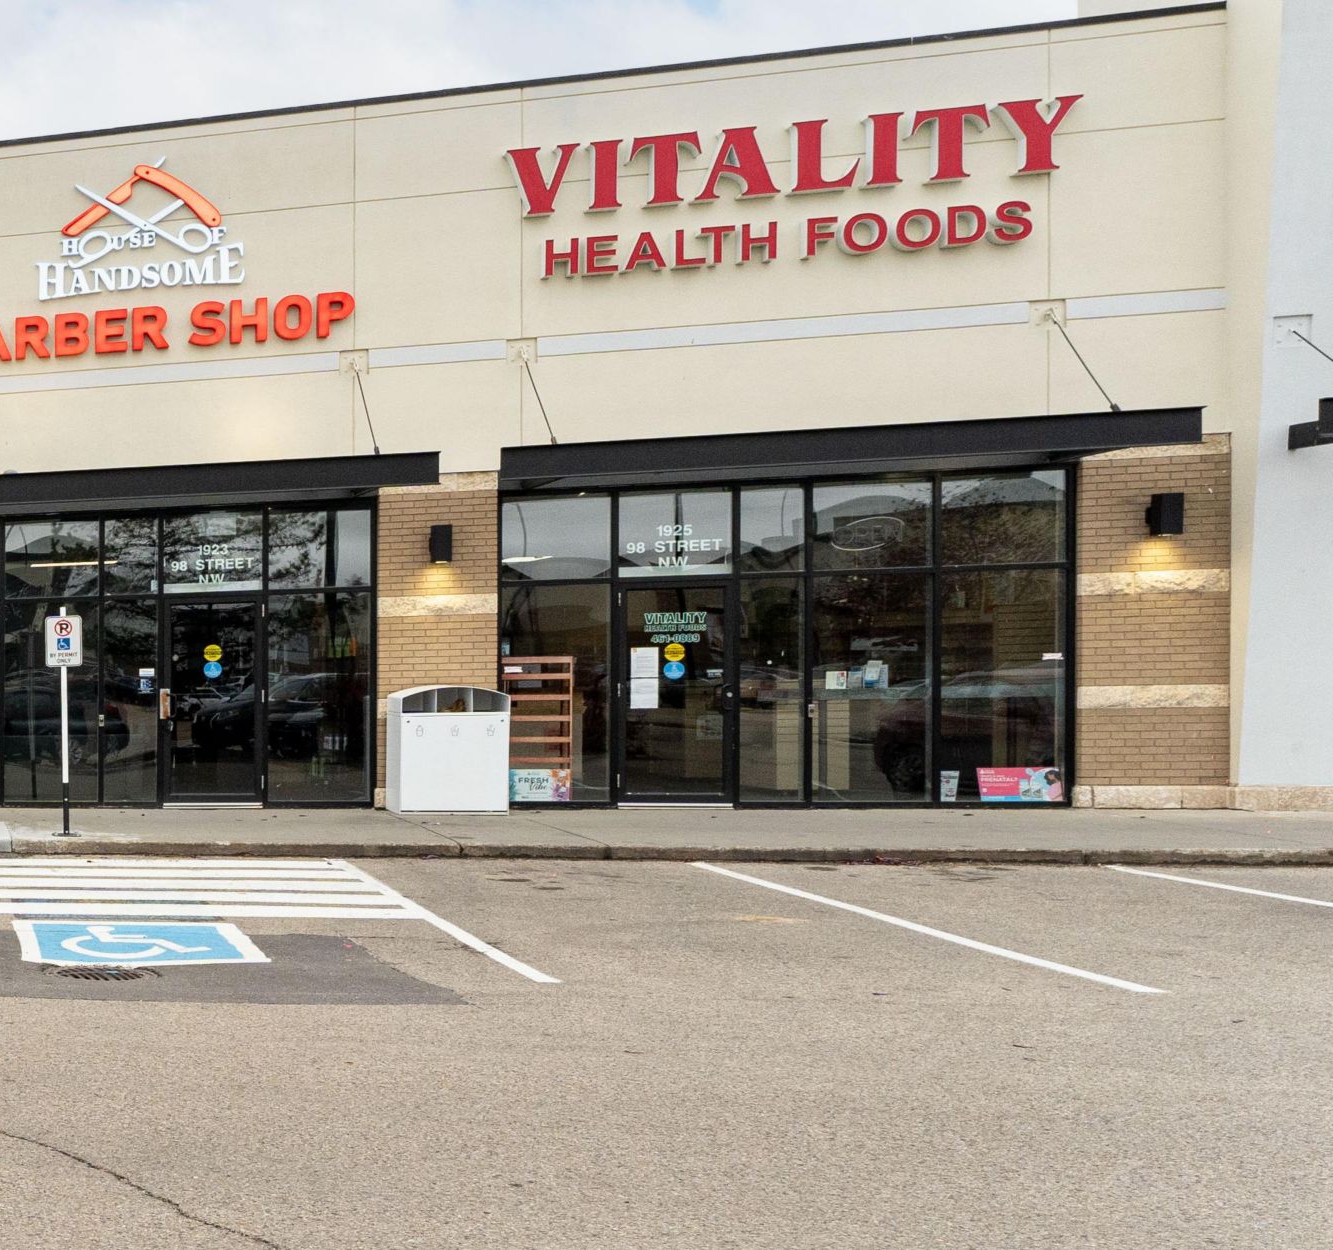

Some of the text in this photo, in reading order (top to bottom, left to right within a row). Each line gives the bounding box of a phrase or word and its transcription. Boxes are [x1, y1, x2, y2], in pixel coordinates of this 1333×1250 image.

[505, 94, 1084, 218] VITALITY
[60, 230, 156, 260] HOUSE
[540, 201, 1033, 279] HEALTH FOODS
[35, 242, 245, 301] HANDSOME
[188, 291, 356, 346] SHOP
[656, 524, 692, 536] 1925
[198, 544, 228, 555] 1923
[626, 539, 723, 553] 98 STREET
[171, 557, 254, 571] 98 STREET
[644, 611, 707, 625] VITALITY
